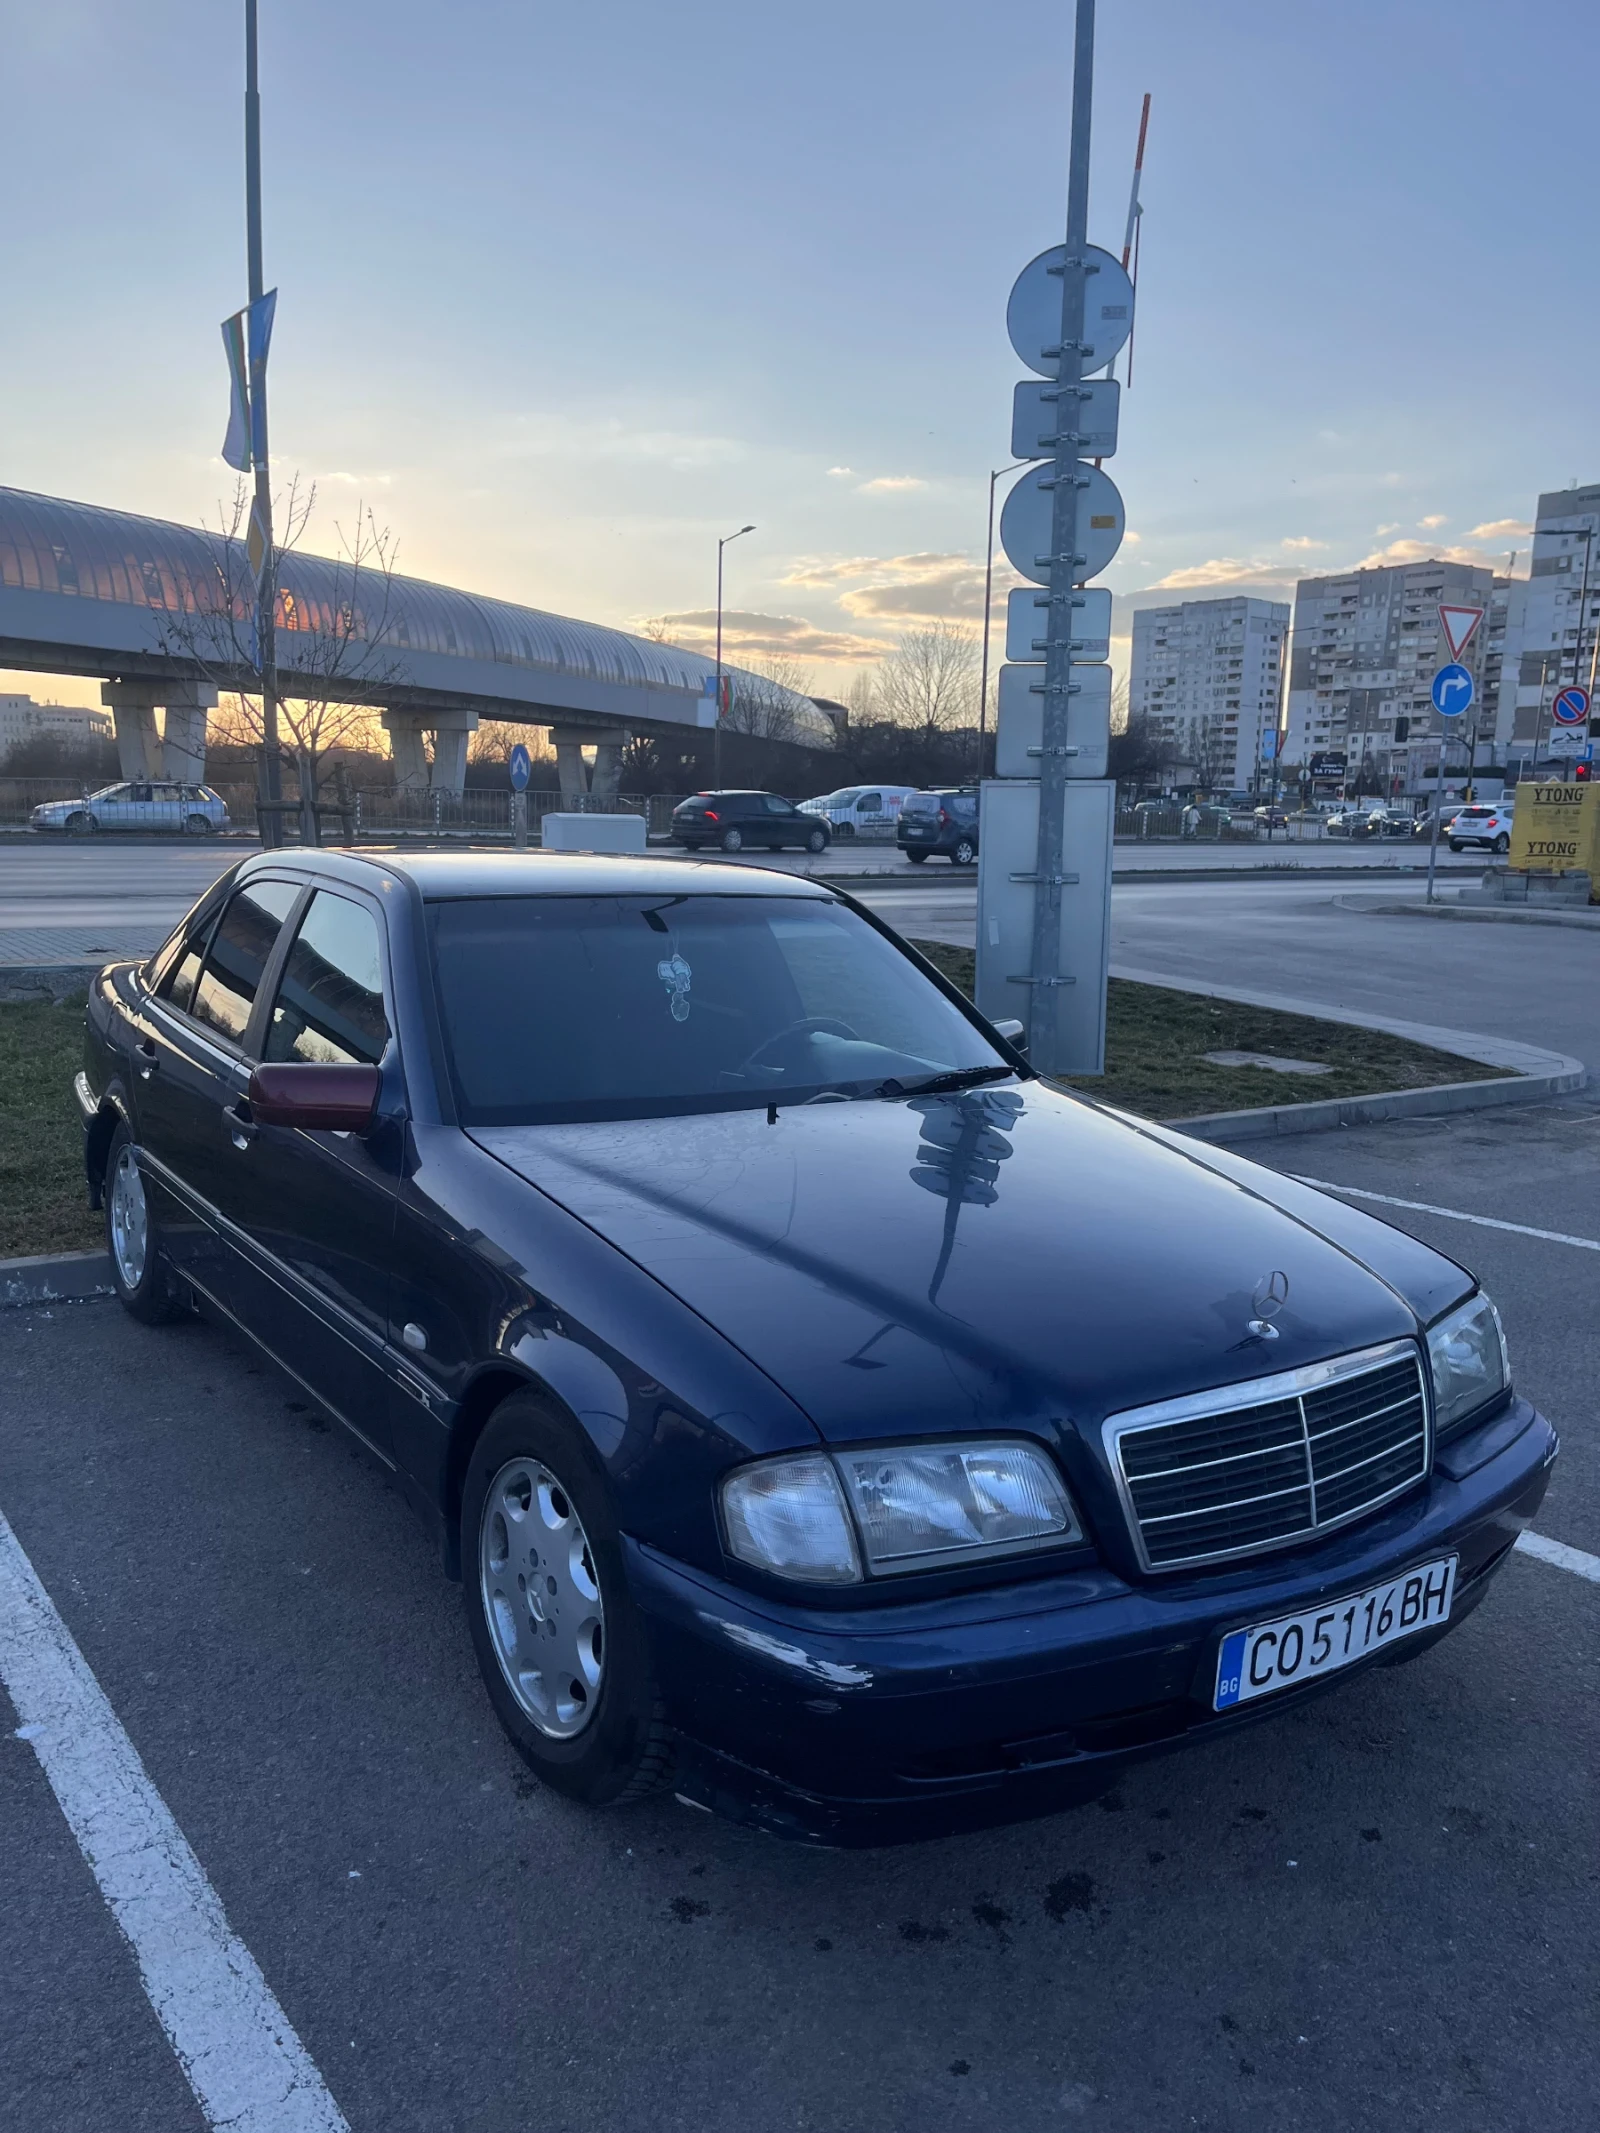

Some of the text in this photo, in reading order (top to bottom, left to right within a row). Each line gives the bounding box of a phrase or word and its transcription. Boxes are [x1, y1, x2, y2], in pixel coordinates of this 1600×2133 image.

[1534, 787, 1584, 802] YTONG
[1527, 841, 1577, 855] YTONG
[1220, 1677, 1238, 1697] BG
